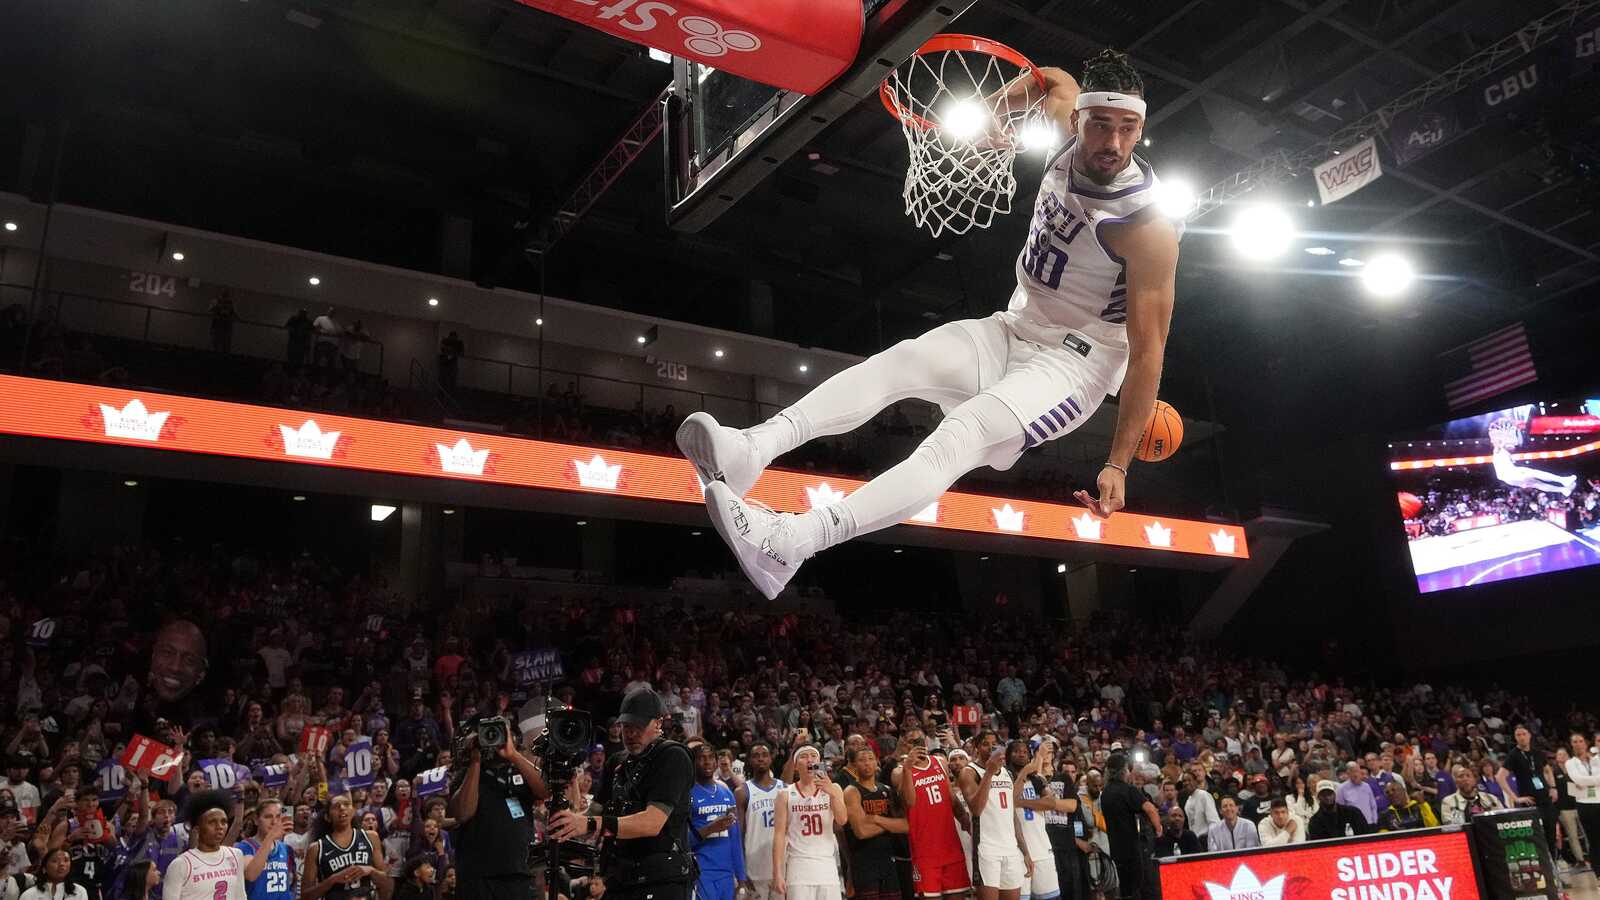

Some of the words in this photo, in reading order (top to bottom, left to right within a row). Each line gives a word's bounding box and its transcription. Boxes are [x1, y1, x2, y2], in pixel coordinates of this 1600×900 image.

[572, 0, 677, 31] St
[1485, 64, 1537, 106] CBU
[1408, 128, 1443, 145] ACU
[1320, 146, 1373, 190] WAC
[129, 271, 176, 298] 204
[657, 360, 688, 381] 203
[728, 498, 751, 537] AMEN
[32, 617, 56, 639] 10
[367, 614, 384, 631] 10
[514, 650, 558, 669] SLAM
[957, 707, 977, 722] 10
[307, 731, 327, 752] 10
[129, 743, 173, 775] 10
[344, 748, 371, 778] 10
[99, 765, 126, 791] 10
[203, 763, 235, 790] 10
[914, 773, 945, 787] ARIZONA
[925, 785, 943, 805] 16
[999, 791, 1008, 809] 0
[791, 802, 829, 813] HUSKERS
[762, 810, 775, 828] 12
[801, 814, 823, 836] 30
[83, 861, 95, 880] 4
[328, 851, 369, 872] BUTLER
[1337, 848, 1439, 882] SLIDER
[213, 880, 228, 900] 2
[266, 872, 288, 893] 23
